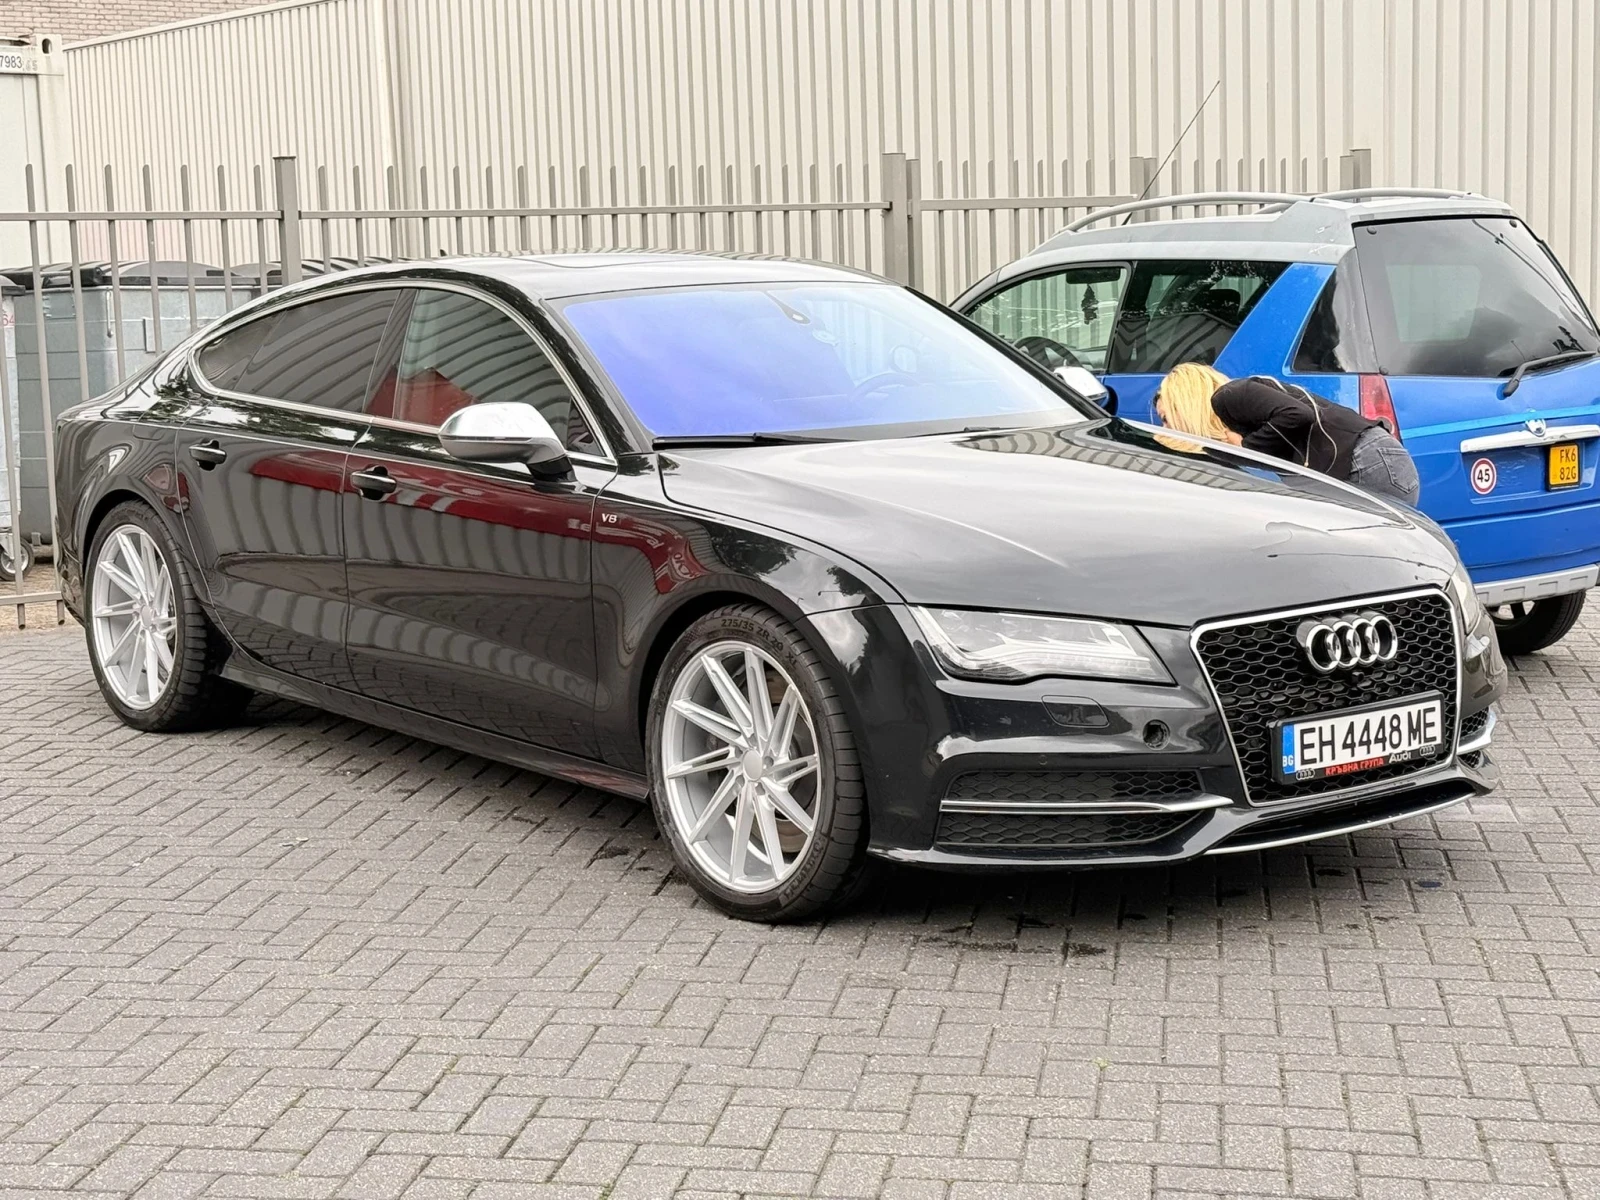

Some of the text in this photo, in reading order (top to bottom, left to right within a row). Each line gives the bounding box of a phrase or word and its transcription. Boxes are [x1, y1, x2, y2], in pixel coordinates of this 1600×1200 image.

[0, 55, 22, 69] 7983
[1560, 448, 1576, 463] FK6
[1477, 469, 1490, 482] 45
[1560, 466, 1577, 480] 82G
[721, 619, 754, 632] 275/35
[1300, 706, 1437, 766] EH 4448 ME
[1282, 754, 1294, 768] BG
[1388, 750, 1412, 764] Audi
[1325, 757, 1385, 776] КРЪВНА ГРУПА
